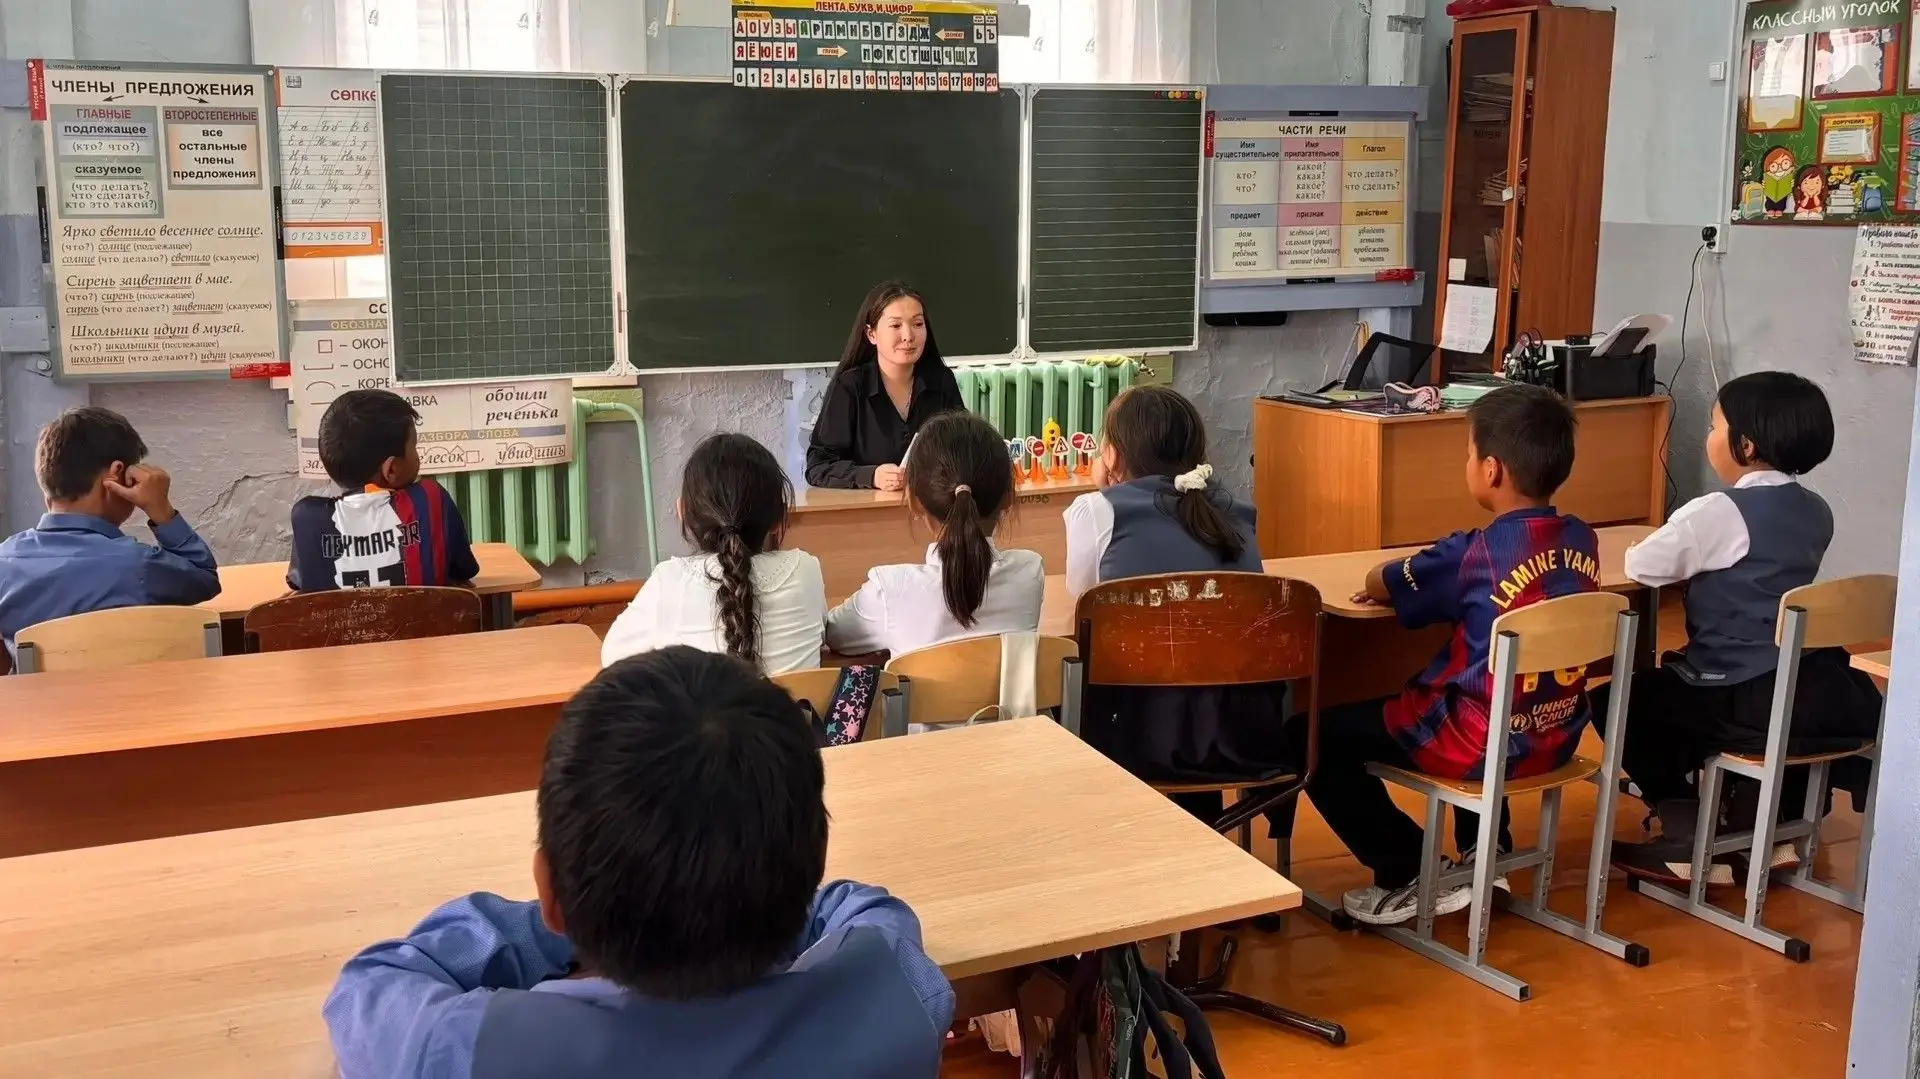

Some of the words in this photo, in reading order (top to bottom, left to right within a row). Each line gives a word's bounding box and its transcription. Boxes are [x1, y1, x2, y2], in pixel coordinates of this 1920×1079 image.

[816, 2, 846, 11] ЛЕНТА
[848, 2, 873, 12] БУКВ
[886, 4, 913, 14] ЦИФР
[1752, 5, 1836, 30] КЛАССНЫЙ
[1841, 0, 1900, 19] УГОЛОК
[737, 22, 744, 34] А
[750, 22, 756, 33] О
[763, 22, 769, 34] У
[786, 23, 796, 34] Ы
[801, 21, 808, 35] Й
[813, 24, 820, 35] Р
[825, 24, 833, 35] Л
[837, 24, 846, 36] М
[875, 26, 882, 37] В
[887, 26, 893, 38] Г
[920, 27, 929, 39] Ж
[976, 29, 982, 39] Ь
[987, 29, 994, 39] Ъ
[737, 46, 744, 57] Я
[749, 43, 755, 57] Ё
[761, 46, 770, 57] Ю
[776, 47, 782, 58] Е
[788, 47, 795, 58] И
[737, 73, 742, 82] 0
[751, 73, 755, 83] 1
[764, 73, 769, 83] 2
[777, 74, 782, 83] 3
[790, 74, 796, 83] 4
[804, 74, 809, 83] 5
[816, 74, 822, 84] 6
[830, 75, 835, 84] 7
[842, 75, 848, 84] 8
[855, 75, 860, 84] 9
[866, 75, 875, 85] 10
[879, 76, 887, 85] 11
[891, 76, 899, 85] 12
[903, 76, 911, 86] 13
[915, 76, 923, 86] 14
[926, 76, 935, 86] 15
[939, 77, 947, 86] 16
[951, 77, 960, 86] 17
[963, 77, 971, 86] 18
[975, 77, 984, 86] 19
[986, 78, 996, 86] 20
[52, 80, 115, 93] ЧЛЕНЫ
[126, 82, 254, 96] ПРЕДЛОЖЕНИЯ
[76, 109, 132, 119] ГЛАВНЫЕ
[165, 110, 257, 120] ВТОРОСТЕПЕННЫЕ
[64, 125, 146, 135] подлежащее
[1278, 126, 1312, 134] ЧАСТИ
[1319, 125, 1346, 134] РЕЧИ
[72, 142, 103, 152] (кто?
[108, 142, 140, 152] что?)
[1215, 151, 1279, 159] существительное
[75, 166, 142, 175] сказуемое
[1296, 162, 1326, 170] какой?
[173, 171, 256, 180] предложения
[1236, 170, 1256, 179] кто?
[1296, 172, 1325, 180] какая?
[1364, 169, 1398, 178] делать?
[72, 183, 96, 193] (что
[101, 182, 148, 192] делать?
[1236, 183, 1256, 192] что?
[1296, 181, 1325, 190] какое?
[1362, 182, 1400, 191] сделать?
[72, 192, 92, 200] что
[96, 191, 150, 201] сделать?
[1295, 190, 1325, 199] какие?
[65, 200, 86, 209] кто
[114, 200, 157, 210] такой?)
[1356, 209, 1388, 217] действие
[63, 225, 96, 240] Ярко
[100, 225, 156, 237] светило
[160, 225, 213, 236] весеннее
[218, 226, 263, 237] солнце.
[61, 243, 94, 252] (что?)
[98, 243, 130, 251] солнце
[62, 255, 95, 264] солнце
[99, 256, 119, 265] (что
[122, 254, 168, 264] делало?)
[171, 253, 210, 262] светило
[213, 254, 260, 263] (сказуемое)
[66, 275, 116, 289] Сирень
[120, 274, 191, 287] зацветает
[195, 273, 202, 284] в
[206, 276, 232, 284] мае.
[65, 293, 98, 302] (что?)
[101, 293, 134, 302] сирень
[66, 305, 99, 315] сирень
[101, 305, 122, 314] (что
[126, 304, 169, 314] делает?)
[172, 302, 223, 312] зацветает
[226, 302, 272, 311] (сказуемое)
[71, 325, 149, 337] Школьники
[154, 323, 188, 338] идут
[192, 323, 200, 334] в
[202, 324, 244, 336] музей.
[69, 344, 102, 352] (кто?)
[71, 356, 125, 364] школьники
[152, 352, 197, 362] делают?)
[201, 352, 226, 362] идут
[229, 351, 275, 360] (сказуемое)
[485, 389, 547, 403] обошли
[485, 408, 558, 425] реченька
[478, 428, 520, 439] СЛОВА
[322, 529, 395, 558] NEYMAR
[397, 520, 421, 546] JR
[1489, 550, 1557, 609] LAMINE
